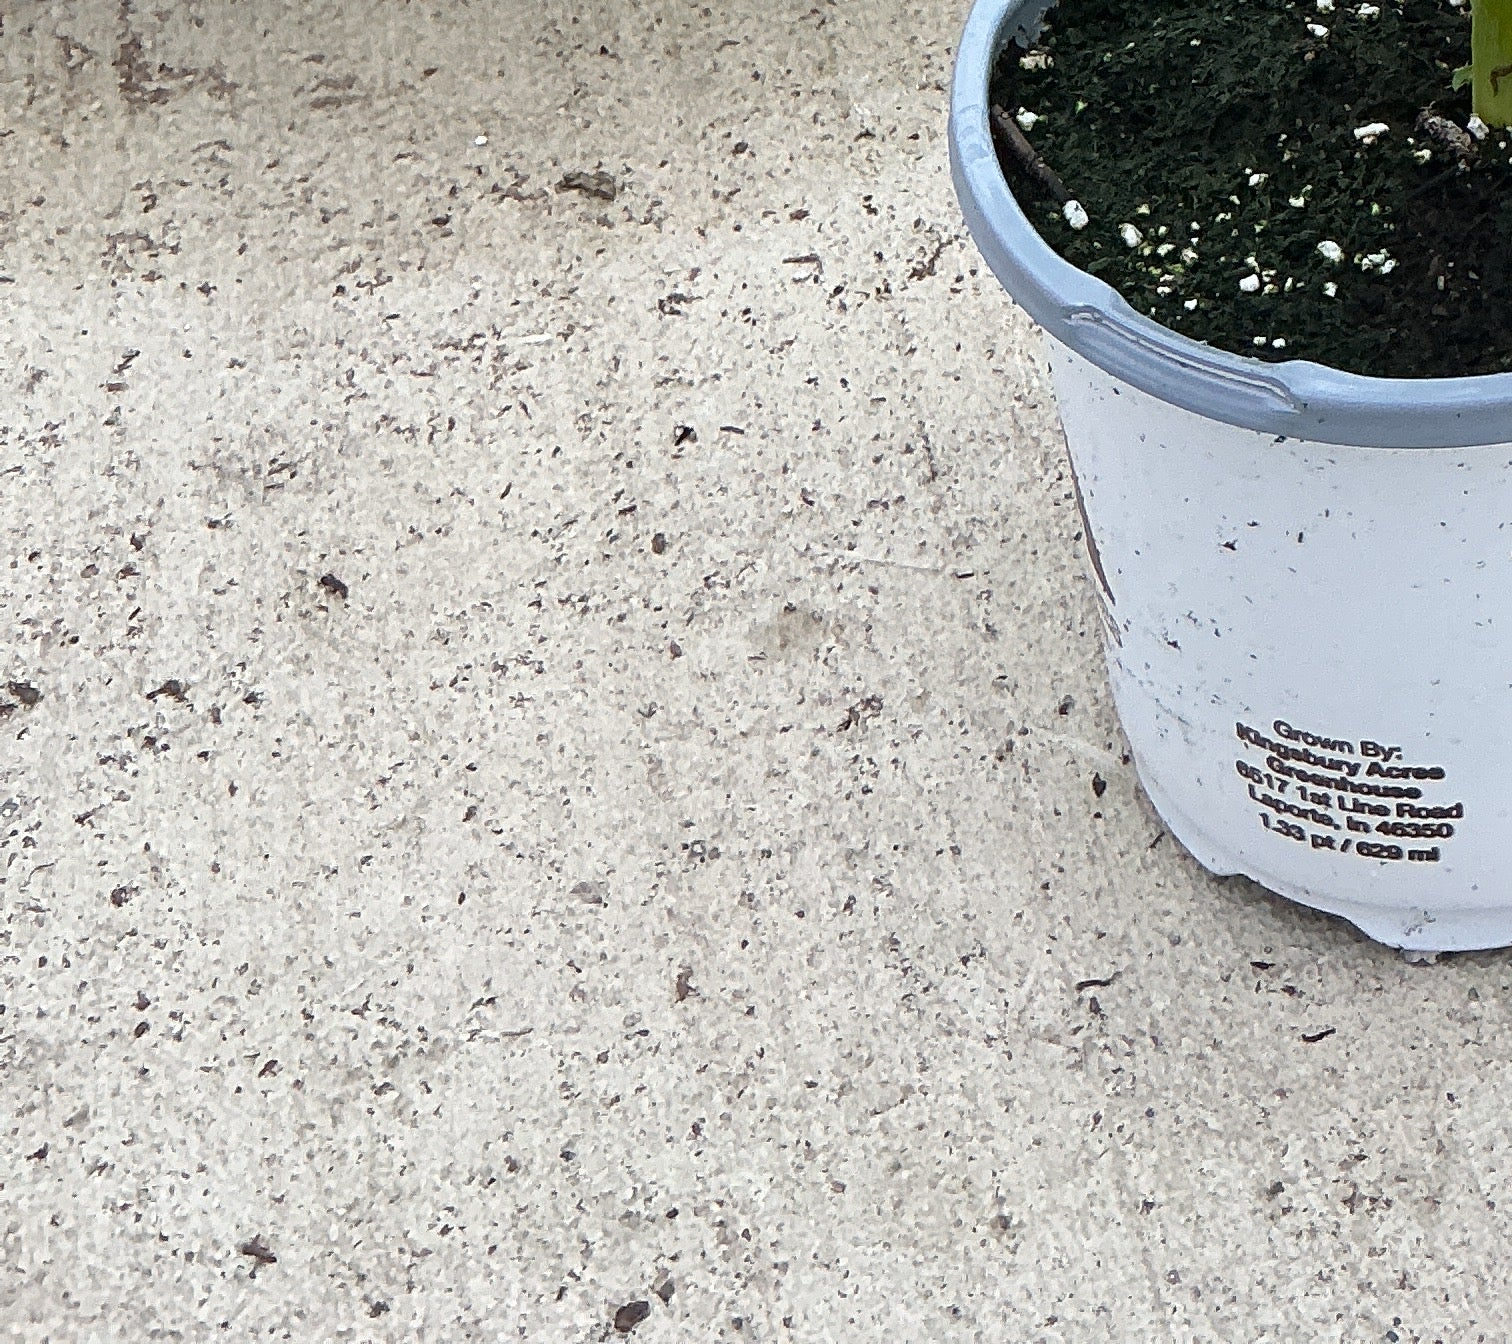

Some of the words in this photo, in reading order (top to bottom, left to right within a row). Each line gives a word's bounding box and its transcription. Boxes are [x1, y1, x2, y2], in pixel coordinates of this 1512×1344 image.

[1236, 721, 1361, 776] Kingsbury
[1366, 761, 1446, 780] Acres
[1273, 719, 1355, 755] Grown
[1359, 740, 1403, 762] By:
[1266, 755, 1423, 799] Greenhouse
[1337, 795, 1391, 816] Line
[1396, 802, 1464, 819] Road
[1310, 833, 1336, 851] pt
[1340, 838, 1352, 853] /
[1356, 841, 1404, 861] 629
[1407, 846, 1441, 862] ml
[1375, 821, 1454, 838] 46350
